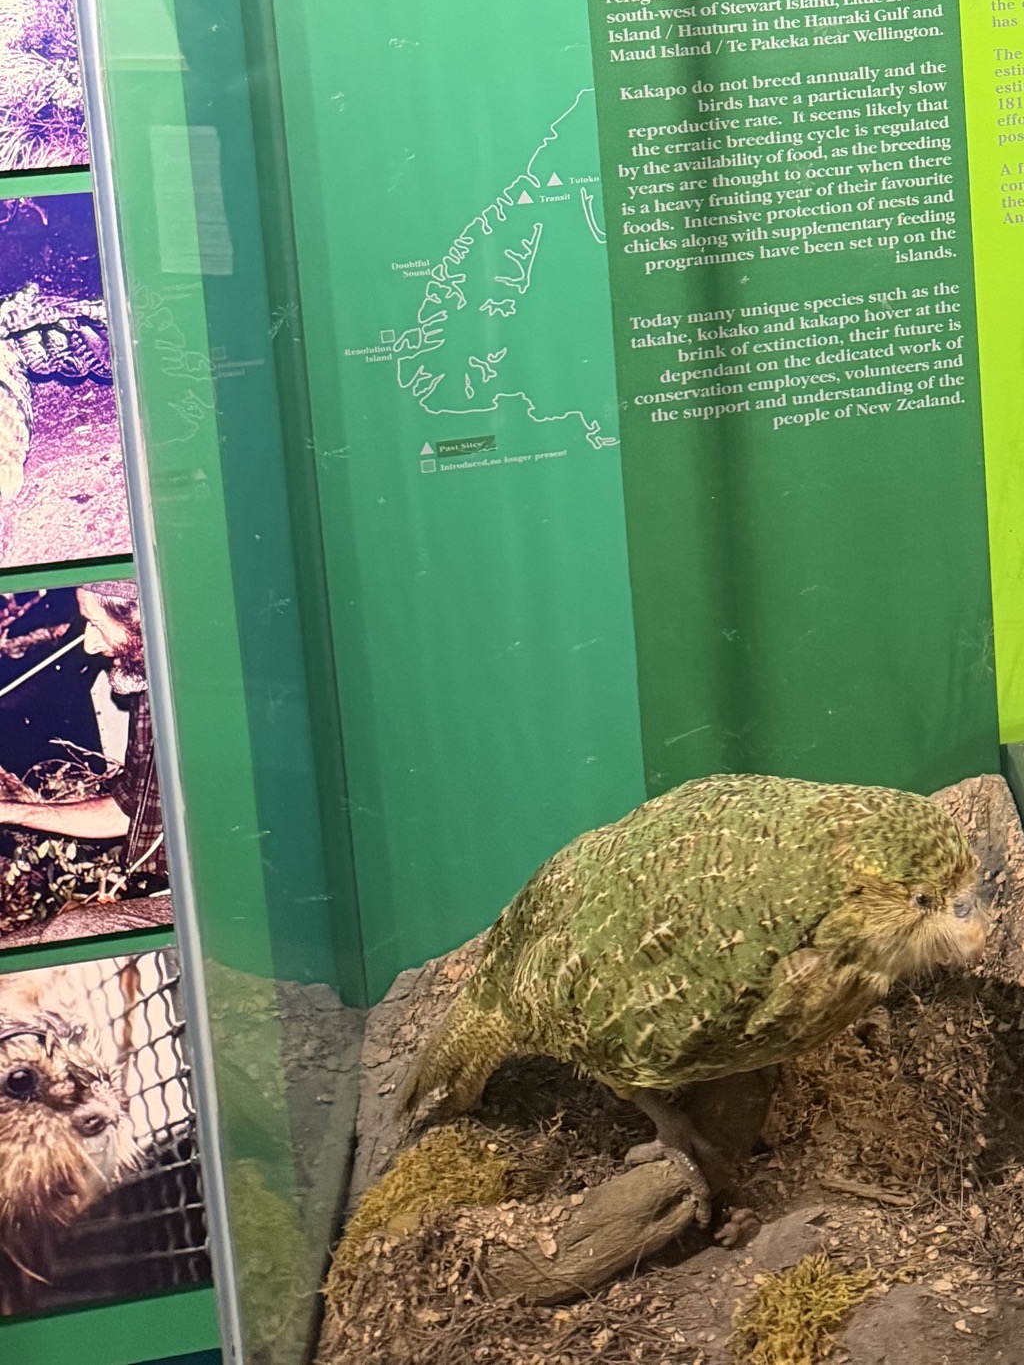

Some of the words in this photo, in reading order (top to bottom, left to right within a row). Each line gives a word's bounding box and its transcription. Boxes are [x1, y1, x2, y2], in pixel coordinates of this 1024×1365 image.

[991, 15, 1018, 28] has
[609, 44, 656, 62] Maud
[660, 40, 711, 58] Island
[726, 39, 746, 52] Te
[750, 33, 809, 50] Pakeka
[812, 33, 850, 46] near
[852, 26, 944, 42] Wellington.
[569, 176, 600, 184] Tutoko
[539, 193, 571, 203] Transit
[895, 245, 956, 263] islands.
[391, 260, 430, 270] Doubtful
[403, 269, 431, 278] Sound
[628, 313, 682, 329] Today
[687, 308, 735, 323] many
[739, 301, 799, 317] unique
[803, 293, 863, 313] species
[868, 286, 907, 303] such
[911, 287, 928, 298] as
[933, 281, 959, 295] the
[344, 345, 392, 356] Resolution
[366, 354, 392, 363] Island
[772, 407, 829, 430] people
[834, 403, 853, 418] of
[856, 402, 891, 416] New
[896, 390, 965, 411] Zealand.
[504, 455, 532, 464] longer
[534, 450, 568, 462] present
